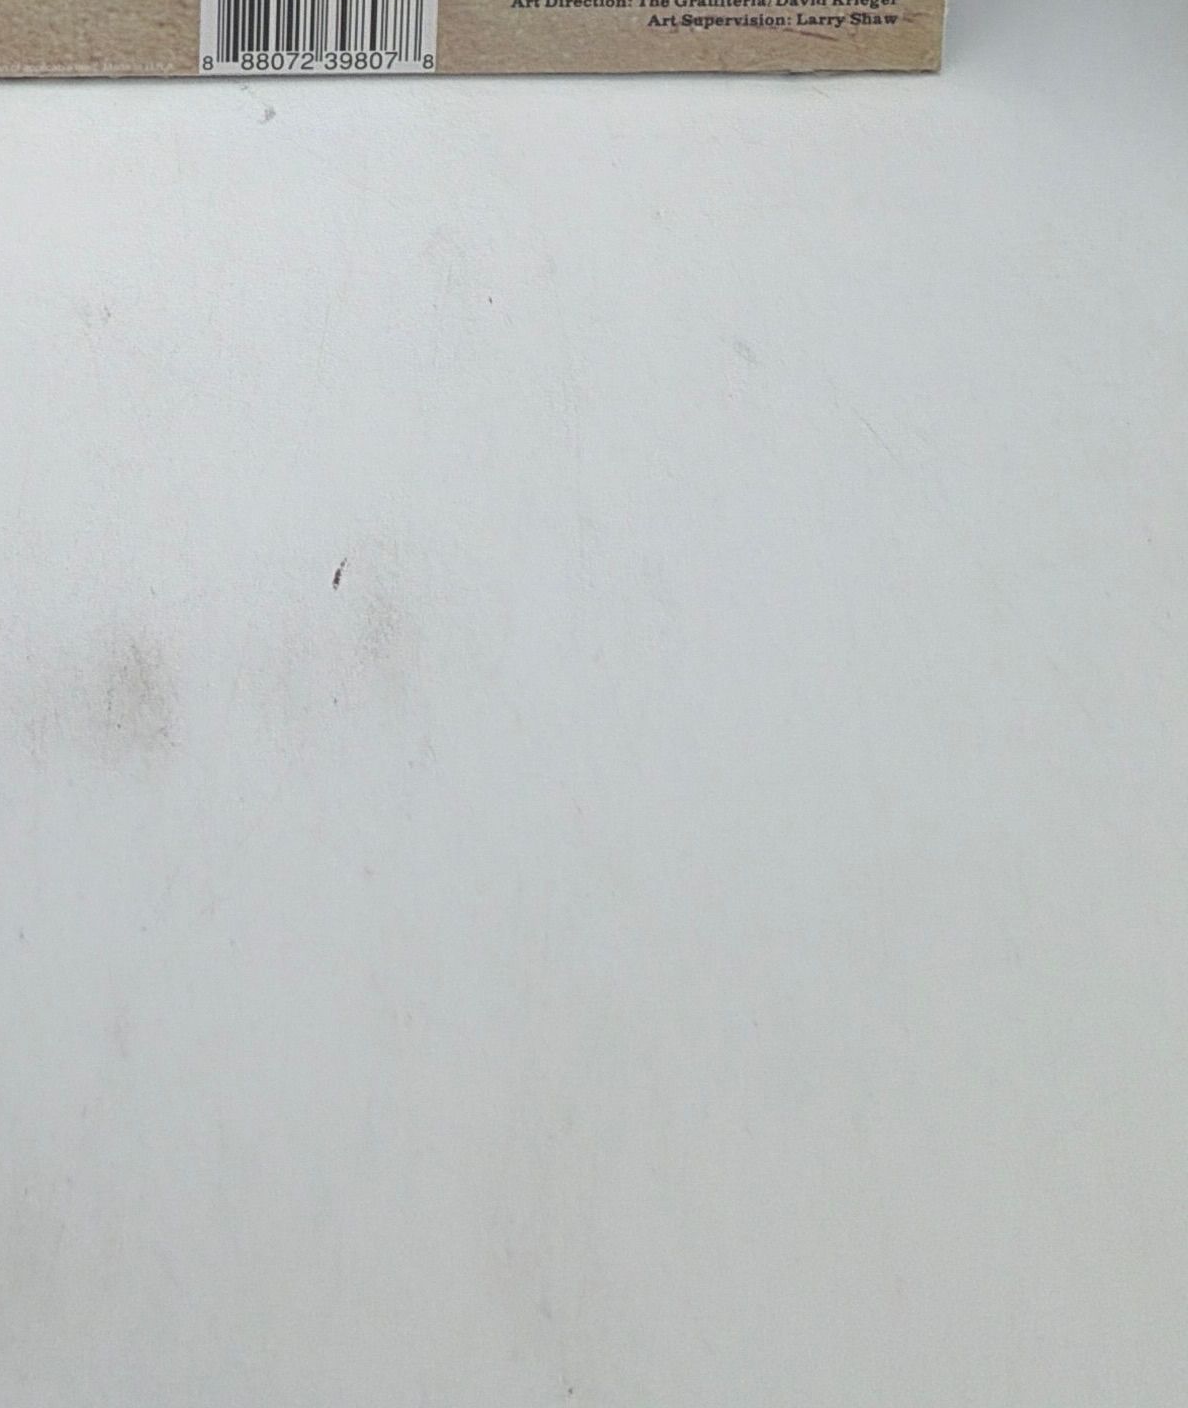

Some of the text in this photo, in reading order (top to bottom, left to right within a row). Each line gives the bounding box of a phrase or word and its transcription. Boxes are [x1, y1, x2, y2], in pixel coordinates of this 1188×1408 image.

[648, 12, 898, 28] Art Supervision: Larry Shaw
[202, 51, 434, 71] 8 88072 39807 8
